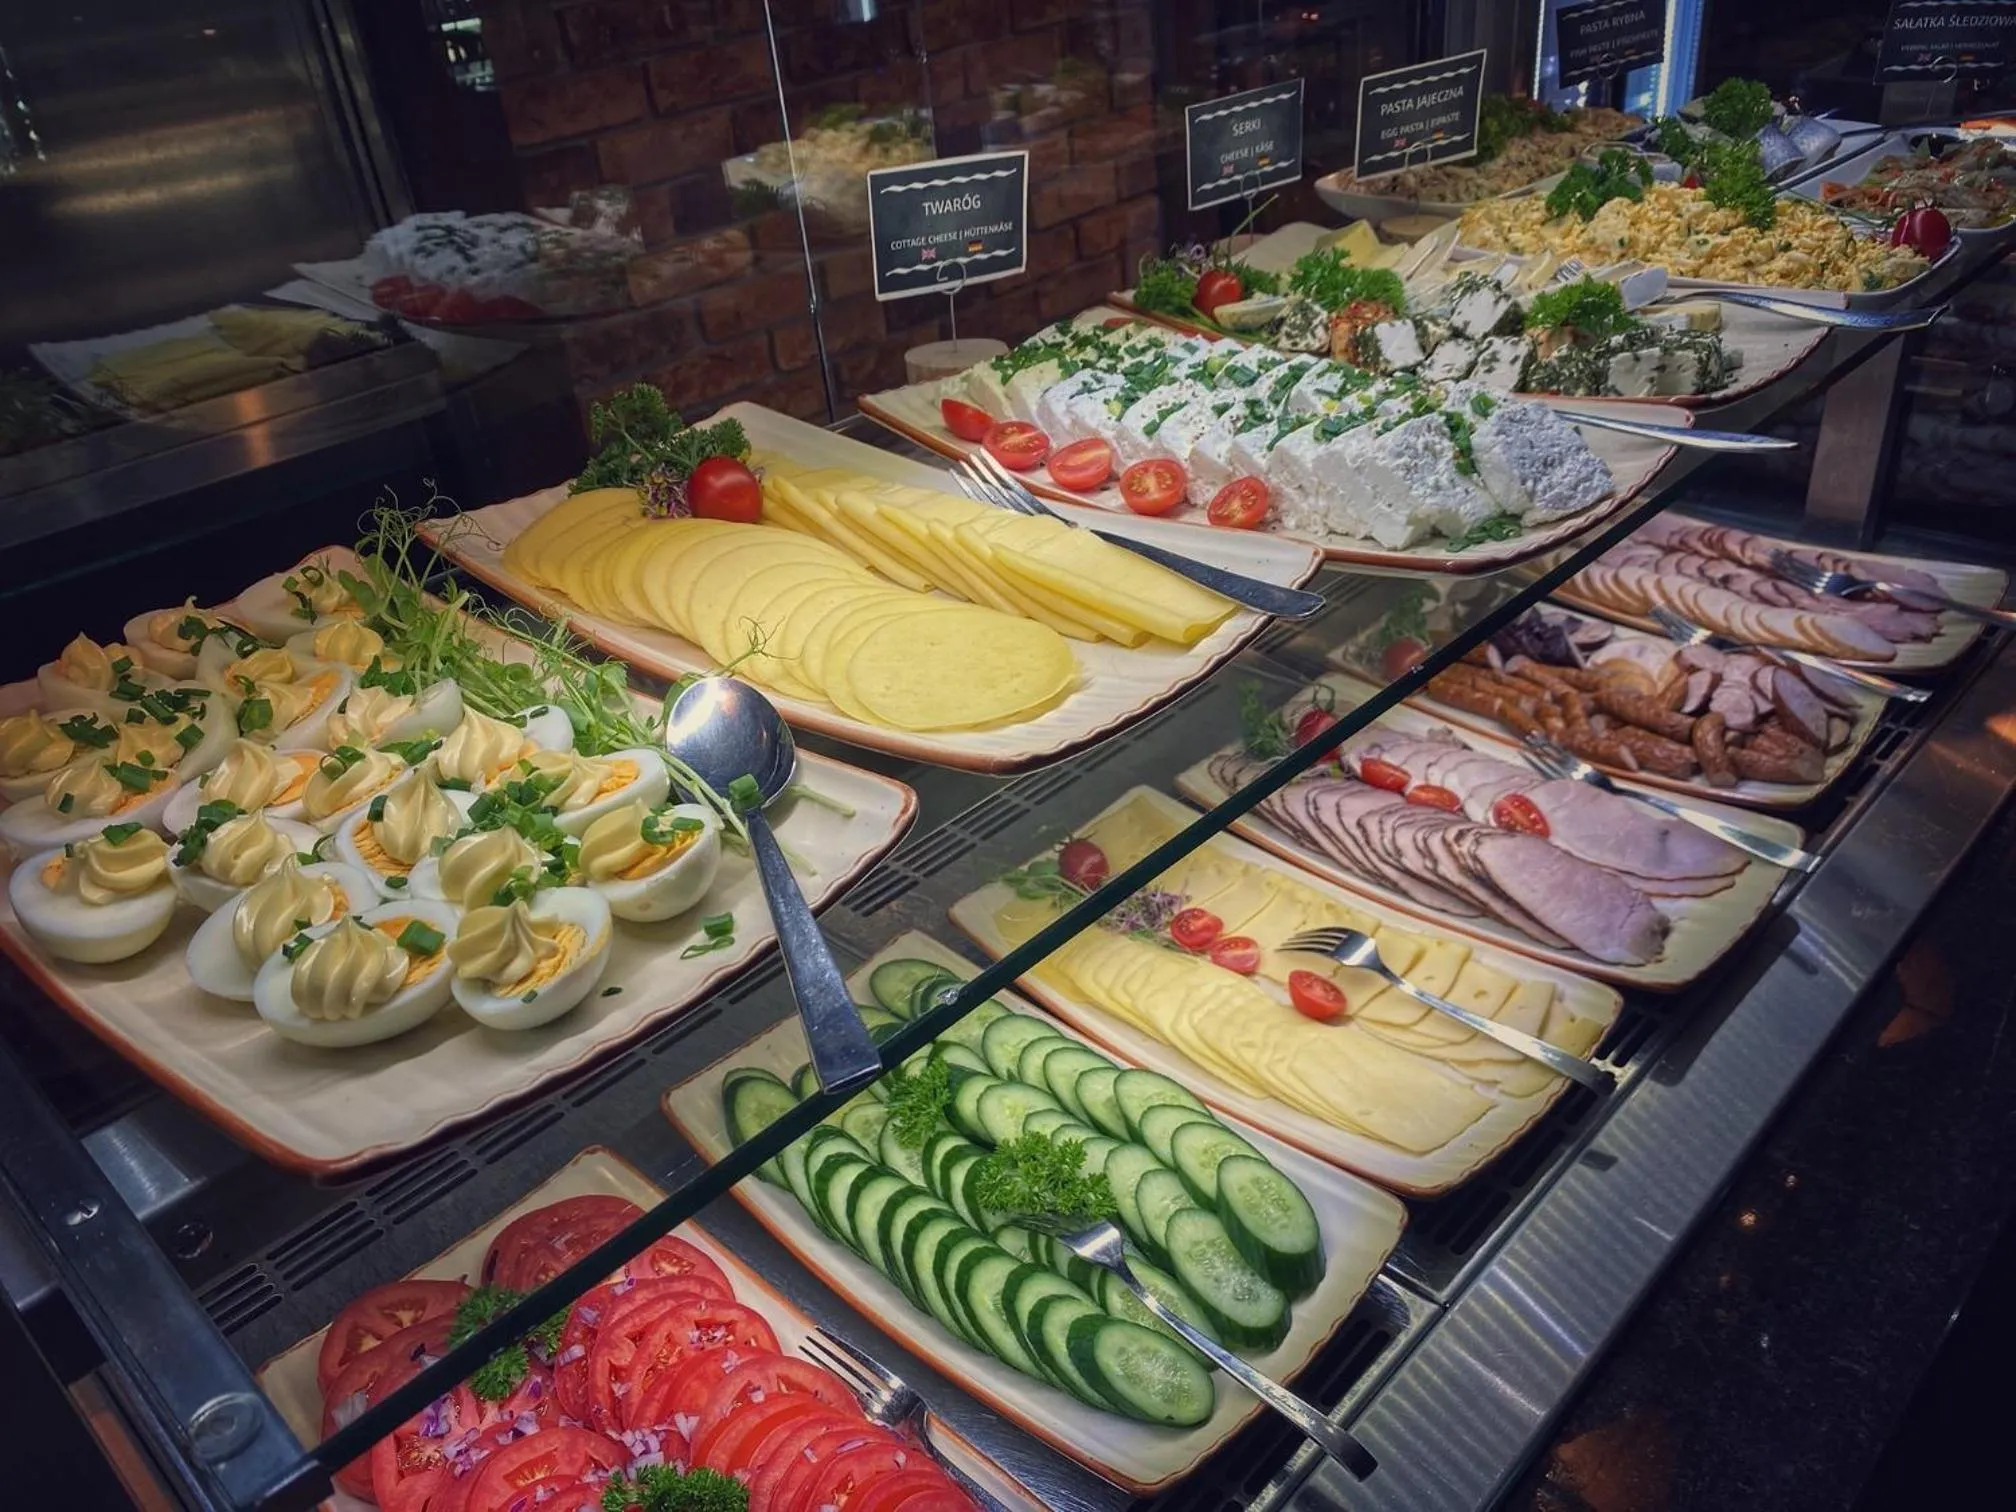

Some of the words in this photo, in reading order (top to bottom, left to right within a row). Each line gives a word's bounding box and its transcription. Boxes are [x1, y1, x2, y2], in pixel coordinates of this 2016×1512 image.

[1893, 16, 1944, 30] SAŁATKA
[1380, 97, 1413, 116] PASTA
[1416, 85, 1464, 110] JAJECZNA
[1232, 118, 1261, 136] SERKI
[1380, 126, 1398, 140] EGG
[1220, 148, 1249, 164] CHEESE
[922, 193, 980, 216] TWARÓG
[891, 238, 926, 250] COTTAGE
[928, 232, 957, 244] CHEESE
[964, 221, 1012, 237] HÜTTENKÄSE
